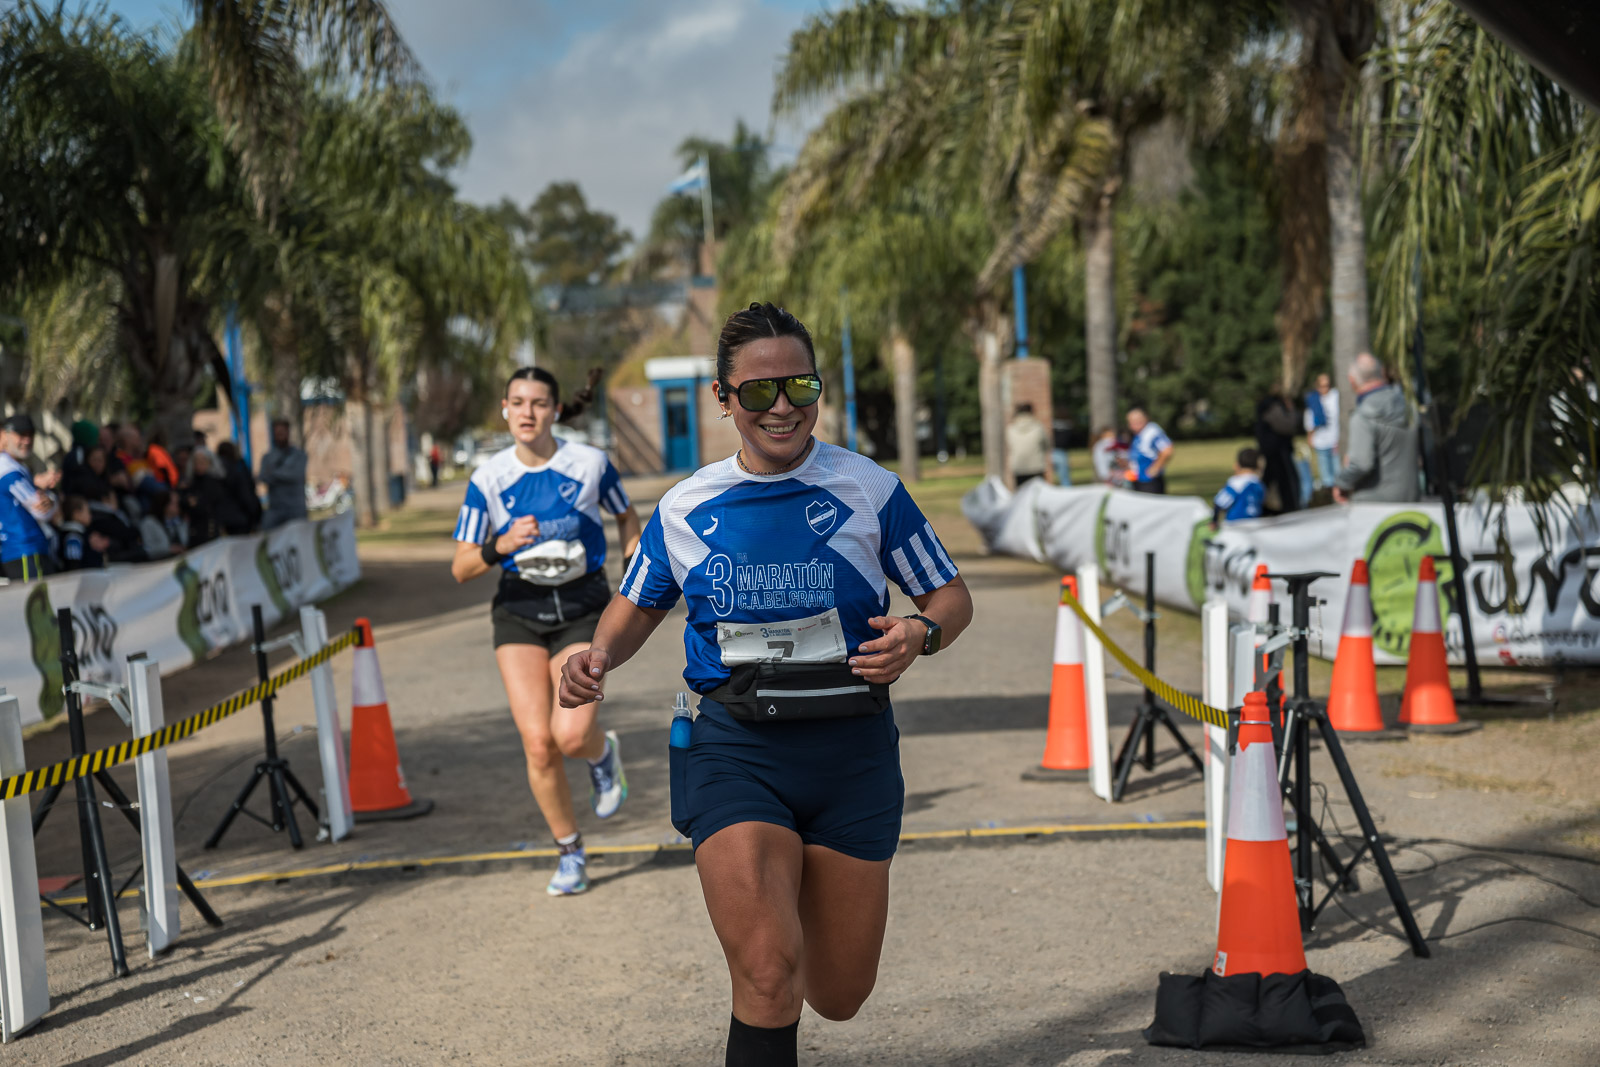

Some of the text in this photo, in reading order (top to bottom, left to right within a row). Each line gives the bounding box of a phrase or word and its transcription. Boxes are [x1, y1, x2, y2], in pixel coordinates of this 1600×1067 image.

[705, 553, 734, 618] 3
[736, 558, 834, 592] MARATÓN
[760, 627, 770, 638] 3
